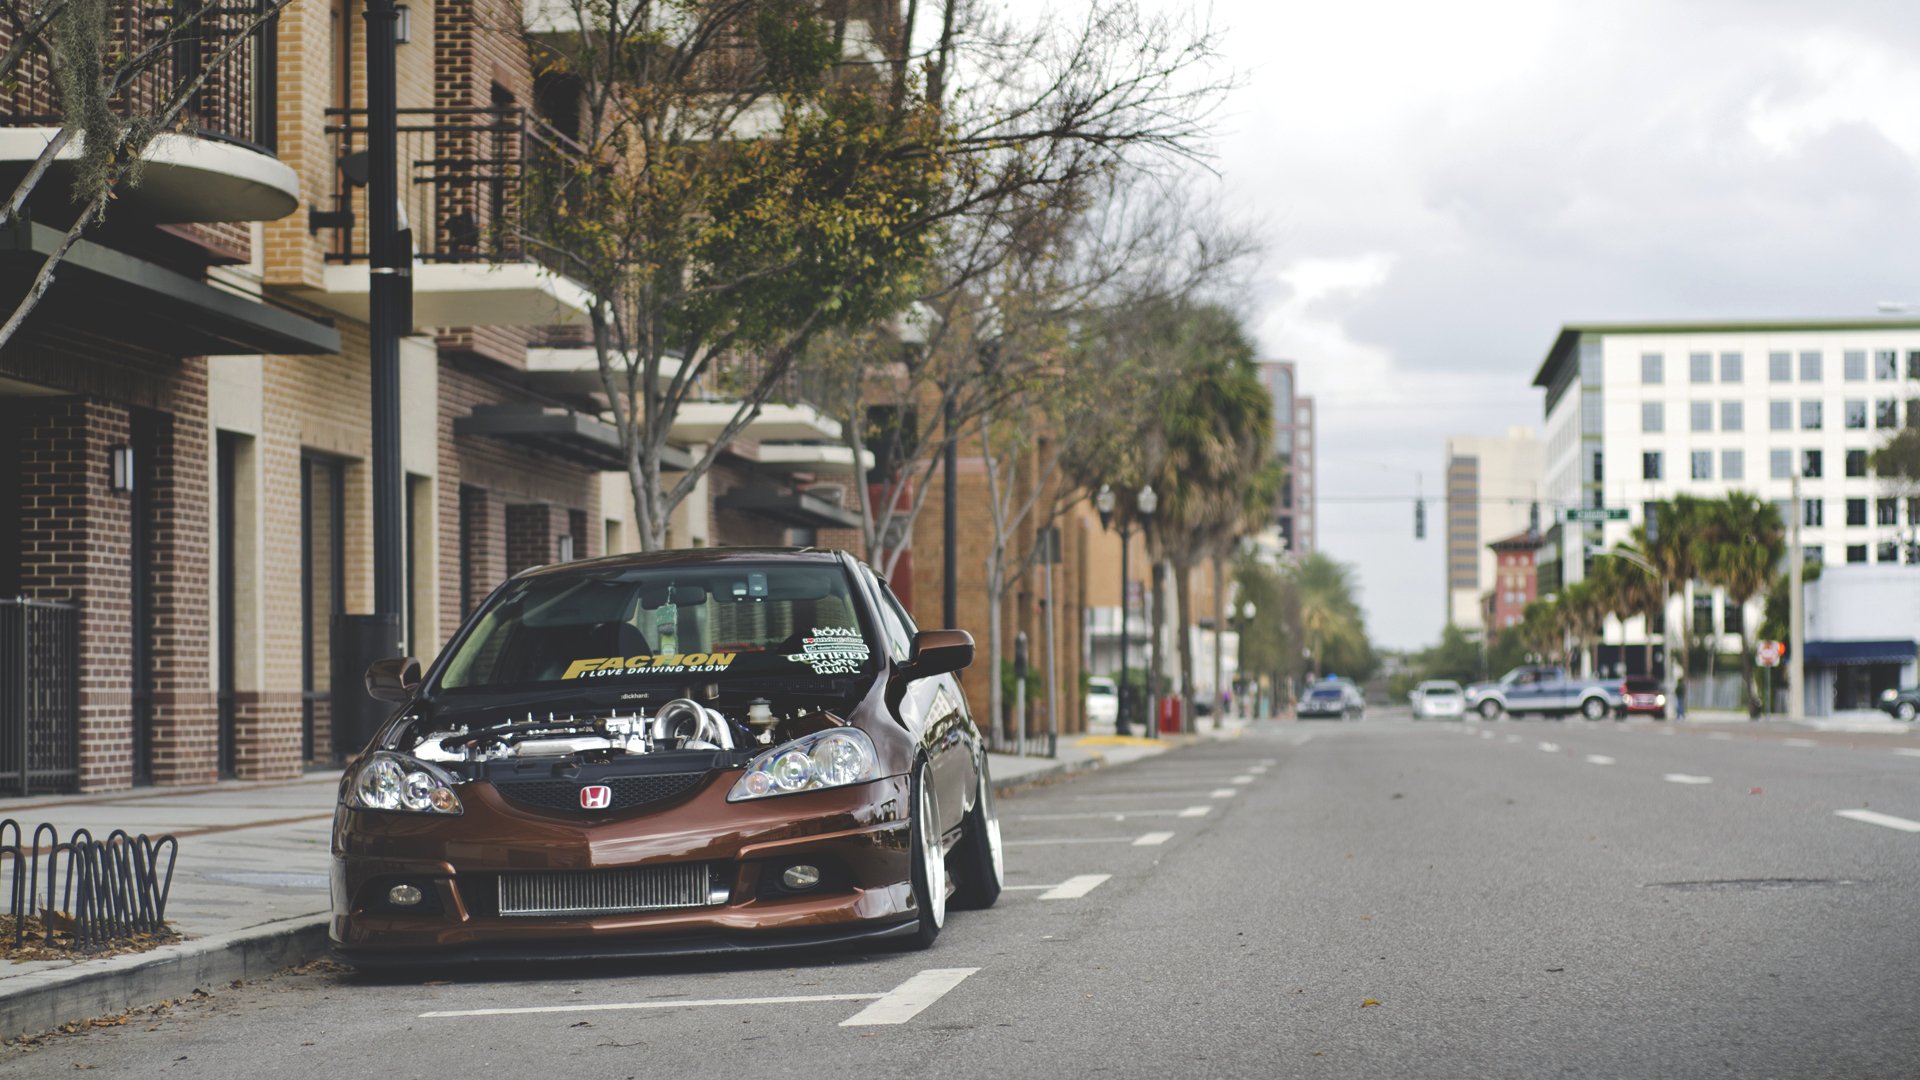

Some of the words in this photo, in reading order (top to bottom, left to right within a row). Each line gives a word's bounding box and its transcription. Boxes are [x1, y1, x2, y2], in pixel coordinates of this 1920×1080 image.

[812, 627, 862, 636] ROYAL
[787, 652, 869, 661] CERTIFIED
[561, 653, 736, 680] FACTION
[589, 669, 624, 677] LOVE
[627, 665, 684, 674] DRIVING
[689, 664, 728, 672] SLOW
